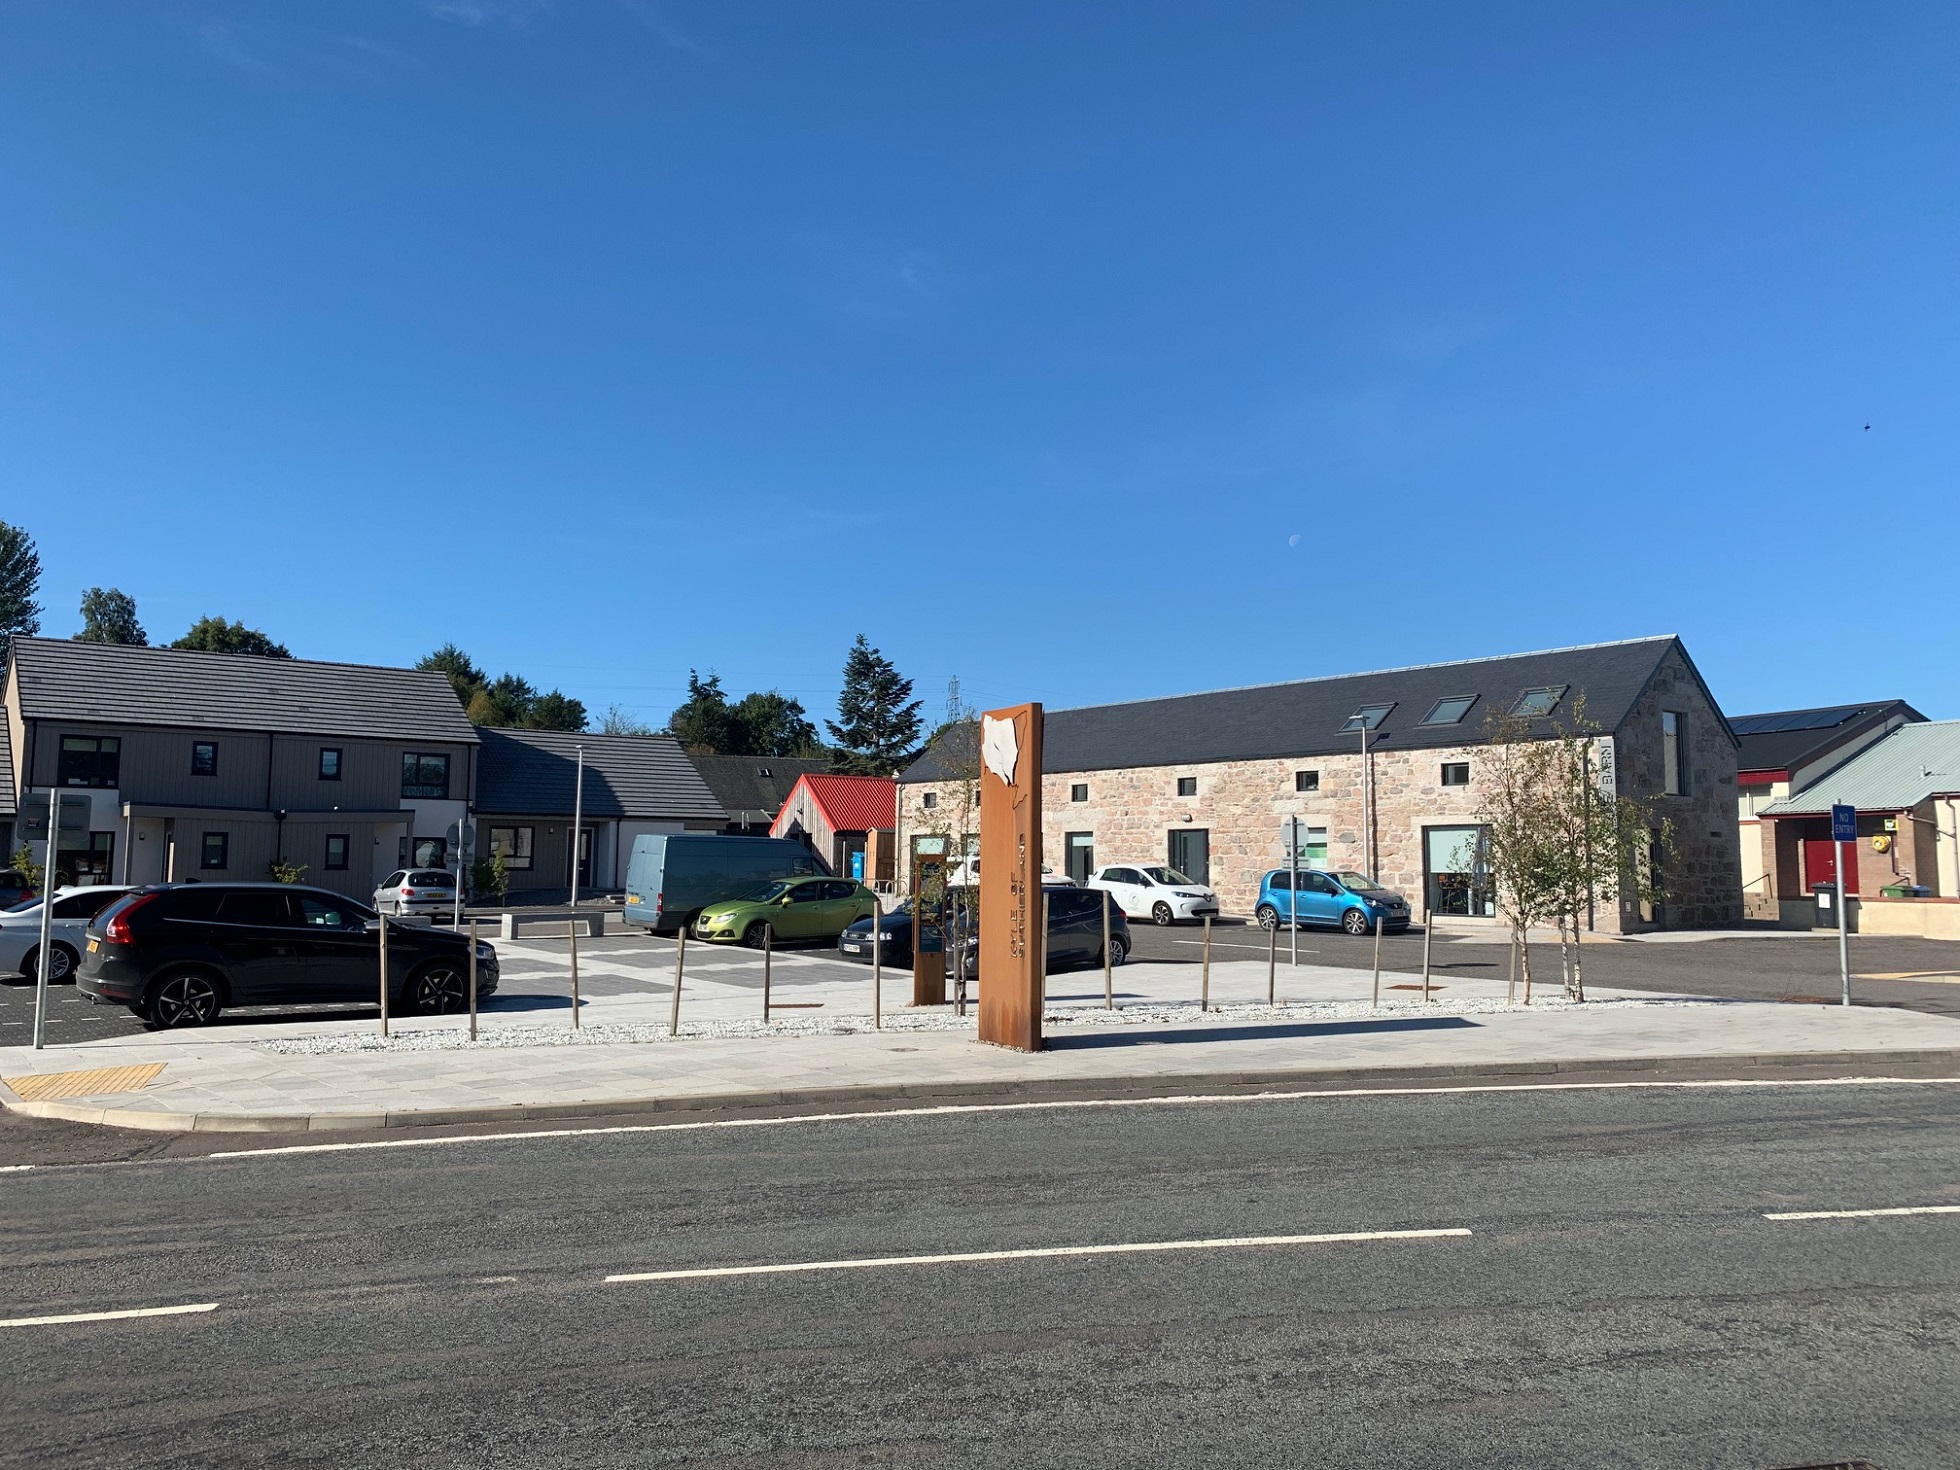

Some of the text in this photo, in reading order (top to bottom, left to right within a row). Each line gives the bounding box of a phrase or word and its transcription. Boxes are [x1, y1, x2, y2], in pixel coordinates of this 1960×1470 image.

[1601, 745, 1613, 785] BARN
[1835, 824, 1855, 834] ENTRY
[1839, 812, 1849, 823] NO
[1010, 871, 1018, 958] KYLE OF
[1018, 832, 1026, 958] SUTHERLAND
